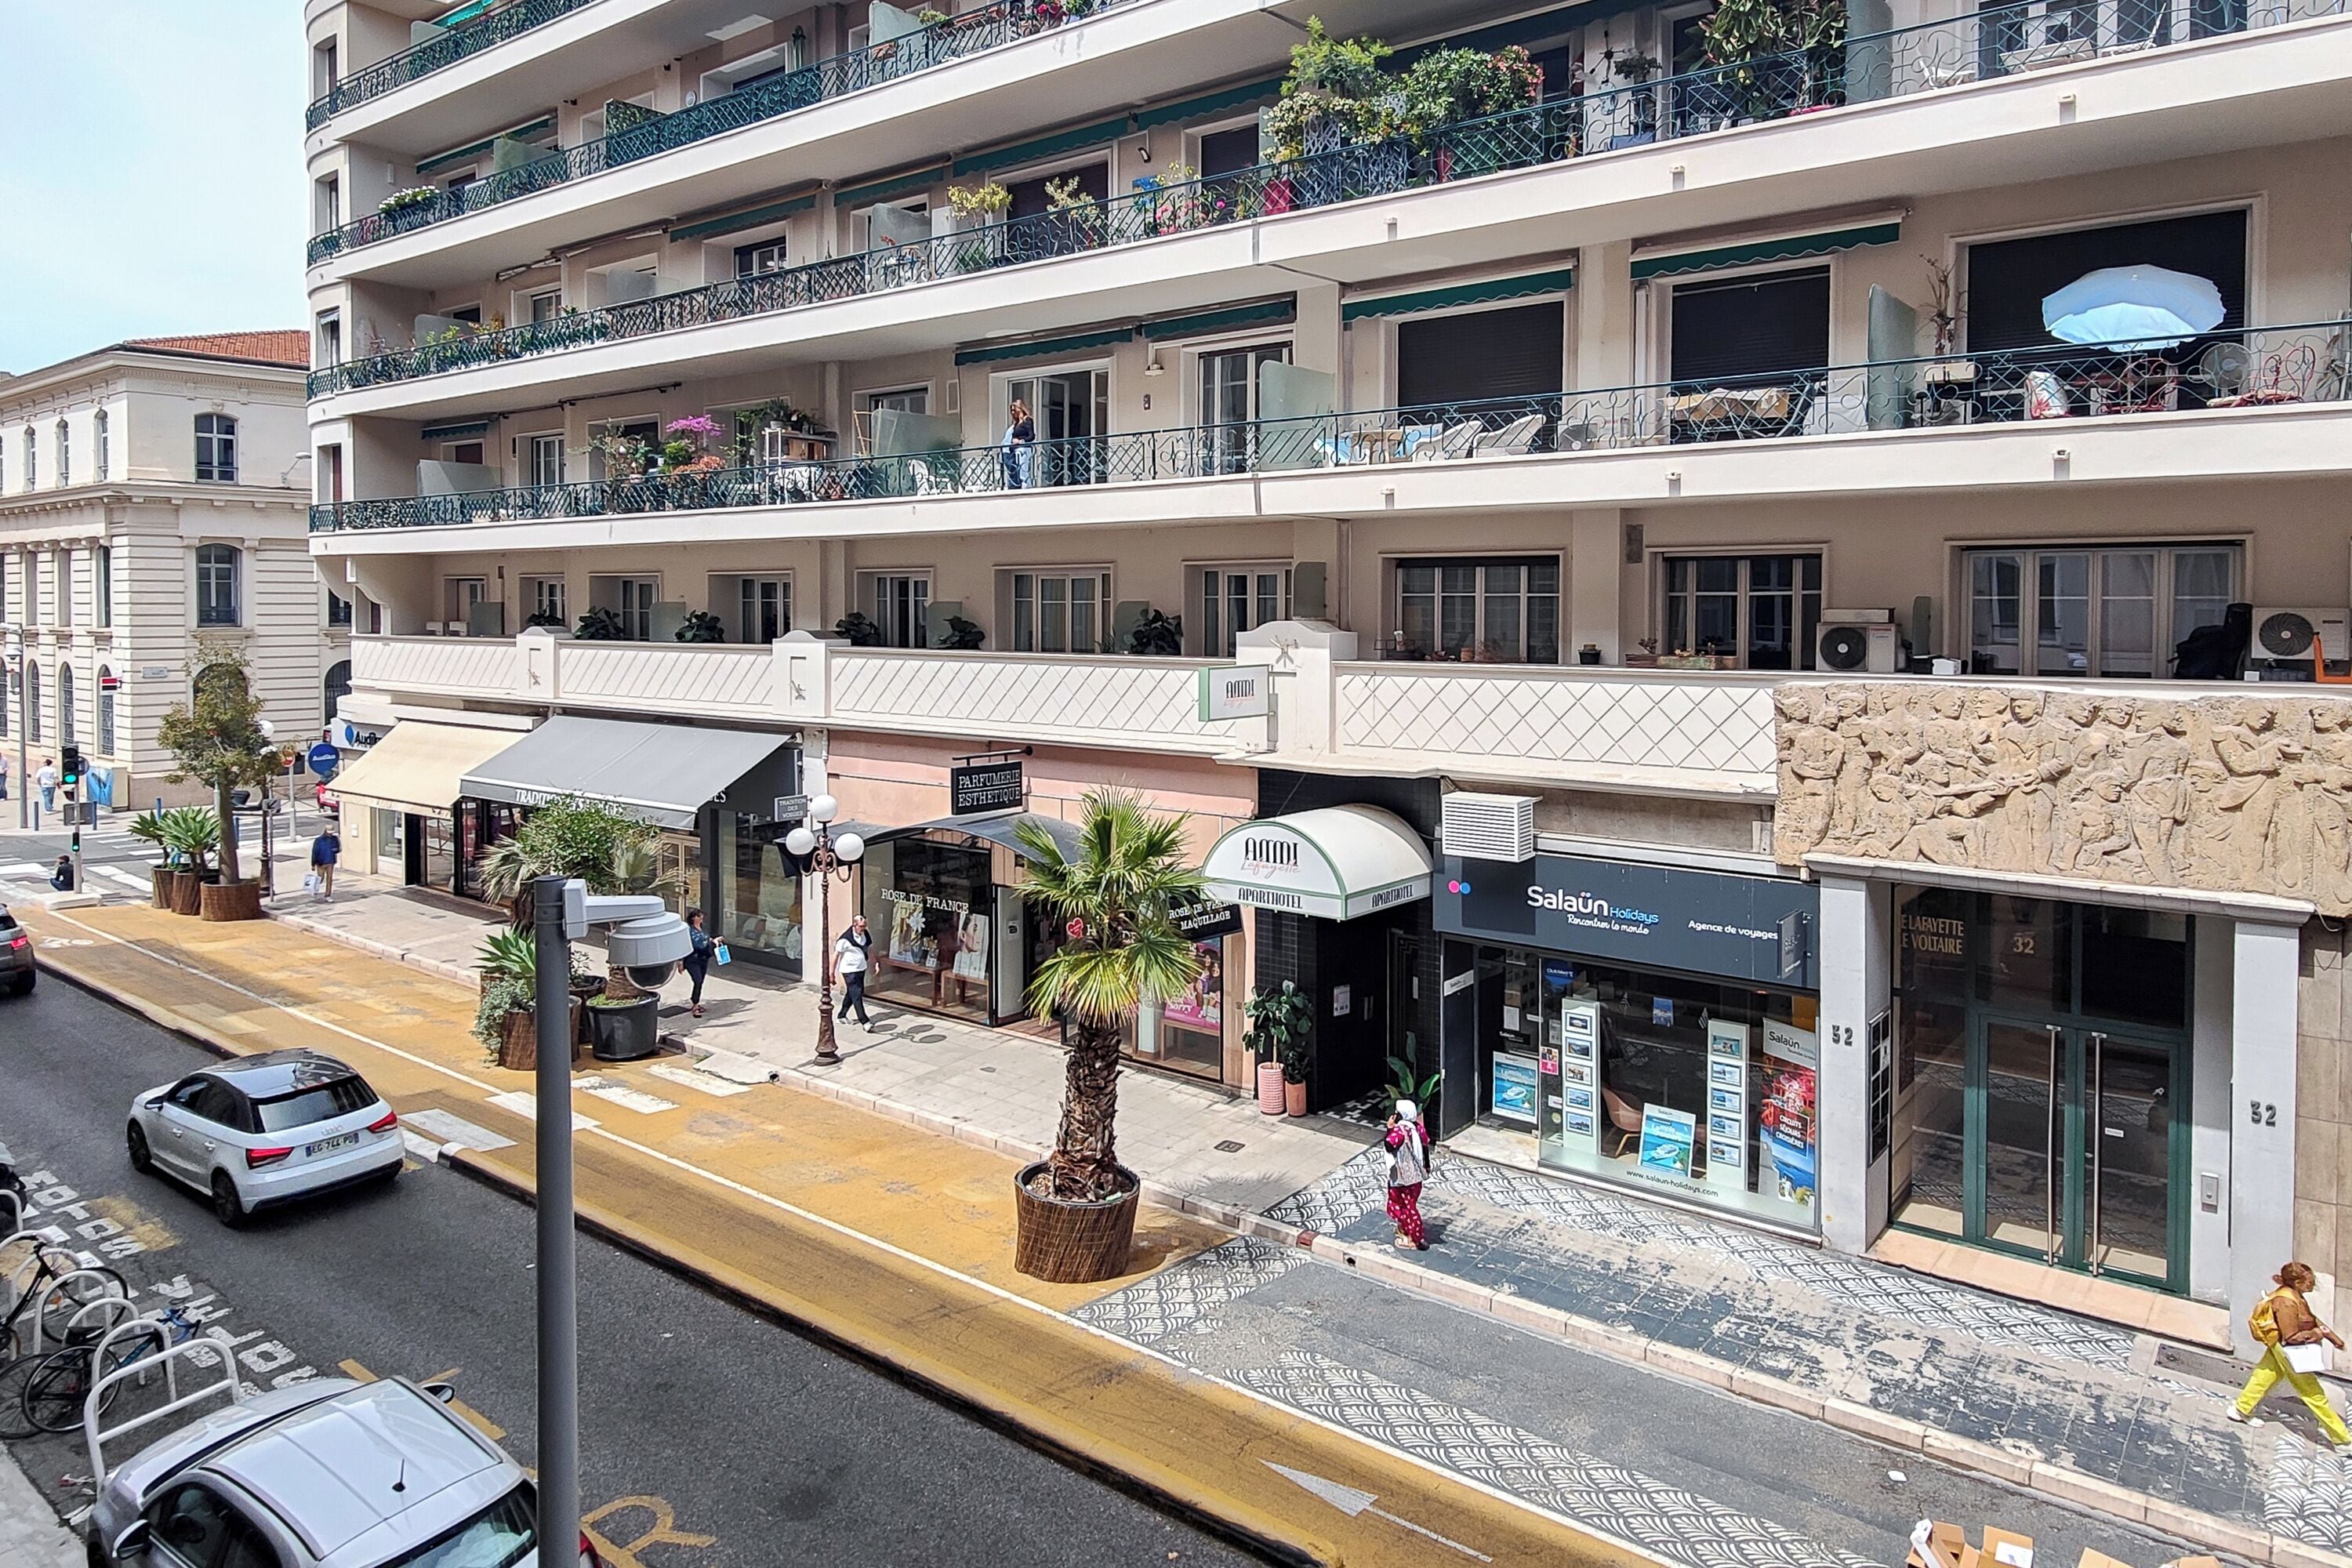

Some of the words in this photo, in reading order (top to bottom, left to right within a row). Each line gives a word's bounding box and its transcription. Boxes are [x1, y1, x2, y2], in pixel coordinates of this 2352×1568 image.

[958, 769, 1021, 789] PARFUMERIE
[957, 787, 1021, 807] ESTHETIQUE
[1240, 855, 1301, 879] Lafayette
[880, 888, 906, 902] ROSE
[909, 893, 923, 905] DE
[926, 896, 969, 913] FRANCE
[1238, 887, 1303, 909] APARTHOTEL
[1371, 884, 1414, 908] APARTHOTEL
[1526, 885, 1610, 916] Salaün
[1610, 906, 1660, 924] Holidays
[1168, 906, 1191, 919] ROSE
[1180, 910, 1231, 931] MAQUILLAGE
[1566, 913, 1610, 929] Rencontrer
[1611, 920, 1620, 931] le
[1621, 923, 1650, 935] monde
[1688, 920, 1722, 932] Agence
[1724, 924, 1737, 934] de
[1737, 927, 1778, 940] voyages
[1909, 915, 1964, 937] LAFAYETTE
[1911, 933, 1962, 955] VOLTAIRE
[2013, 936, 2034, 954] 32
[1768, 1030, 1800, 1050] Salaün
[1626, 1169, 1719, 1197] www.salaun-holidays.com
